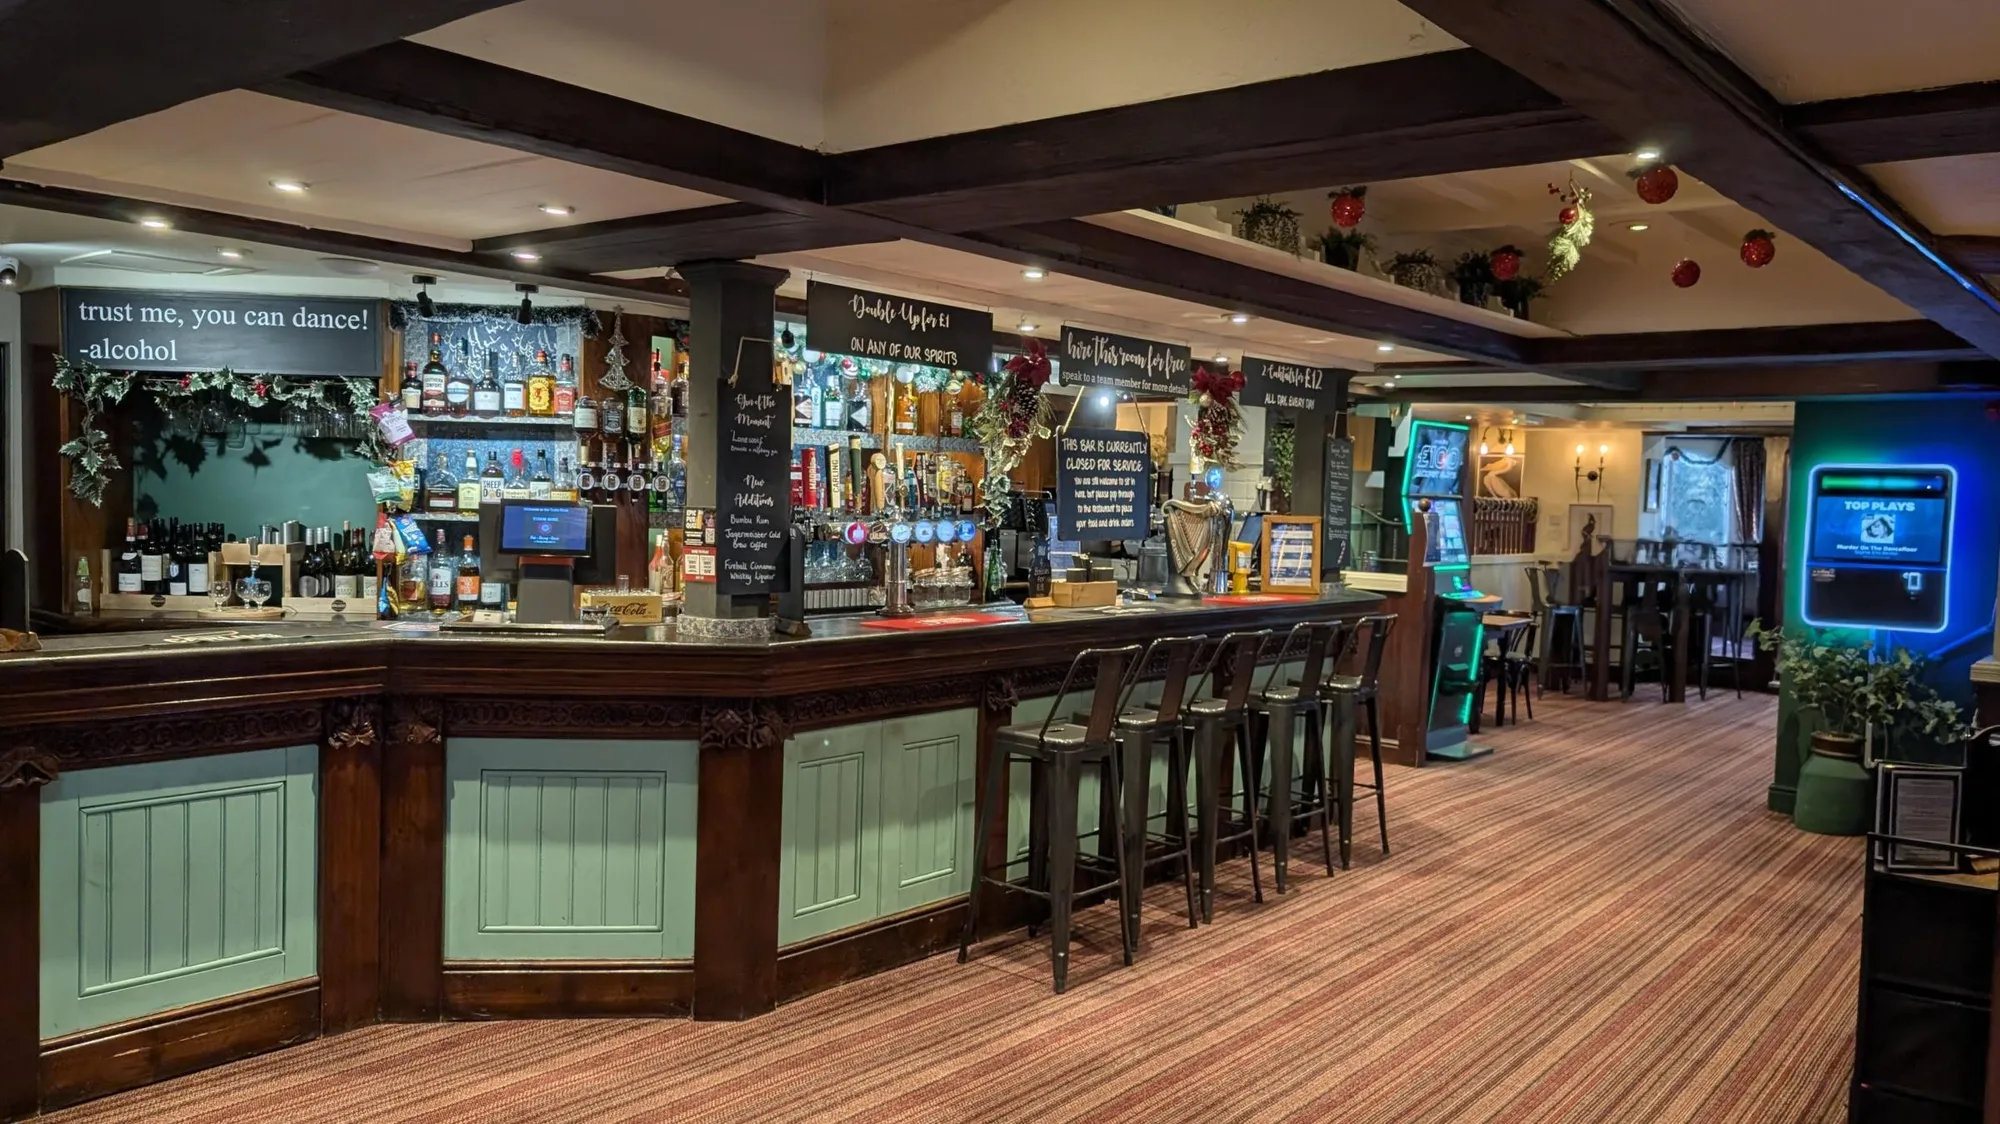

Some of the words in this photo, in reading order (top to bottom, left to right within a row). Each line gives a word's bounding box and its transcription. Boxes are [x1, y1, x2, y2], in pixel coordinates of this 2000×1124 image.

[79, 302, 133, 322] trust
[140, 306, 184, 328] me,
[191, 308, 237, 330] you
[244, 310, 286, 327] can
[292, 306, 368, 330] dance!
[848, 294, 896, 324] Double
[898, 302, 920, 331] Up
[921, 307, 937, 332] for
[939, 313, 950, 328] £1
[79, 337, 178, 361] -alcohol
[851, 337, 864, 352] ON
[867, 338, 887, 356] ANY
[889, 343, 902, 357] OF
[904, 345, 922, 361] OUR
[924, 348, 958, 366] SPIRITS
[1067, 332, 1093, 360] hire
[1092, 335, 1118, 366] this
[1119, 347, 1147, 369] room
[1147, 345, 1164, 378] for
[1165, 348, 1186, 380] free
[1062, 370, 1082, 382] speak
[1083, 374, 1090, 383] to
[1096, 374, 1114, 386] team
[1115, 378, 1141, 389] member
[1141, 379, 1151, 391] for
[1152, 384, 1168, 393] more
[1168, 384, 1188, 395] details
[1261, 364, 1267, 376] 2
[1304, 367, 1323, 390] £12
[1264, 392, 1276, 405] ALL
[1305, 398, 1315, 410] DAY
[735, 412, 776, 429] Moment
[1061, 438, 1078, 451] THIS
[1079, 438, 1096, 453] BAR
[1097, 439, 1105, 453] IS
[1106, 440, 1148, 454] CURRENTLY
[1066, 457, 1096, 471] CLOSED
[1097, 459, 1111, 472] FOR
[1112, 459, 1144, 473] SERVICE
[1416, 444, 1460, 470] £100
[743, 474, 765, 489] New
[831, 459, 839, 493] CARLING
[734, 492, 774, 508] Additions
[1844, 500, 1870, 511] TOP
[1871, 501, 1916, 512] PLAYS
[756, 514, 770, 525] Rum
[768, 530, 781, 539] Cold
